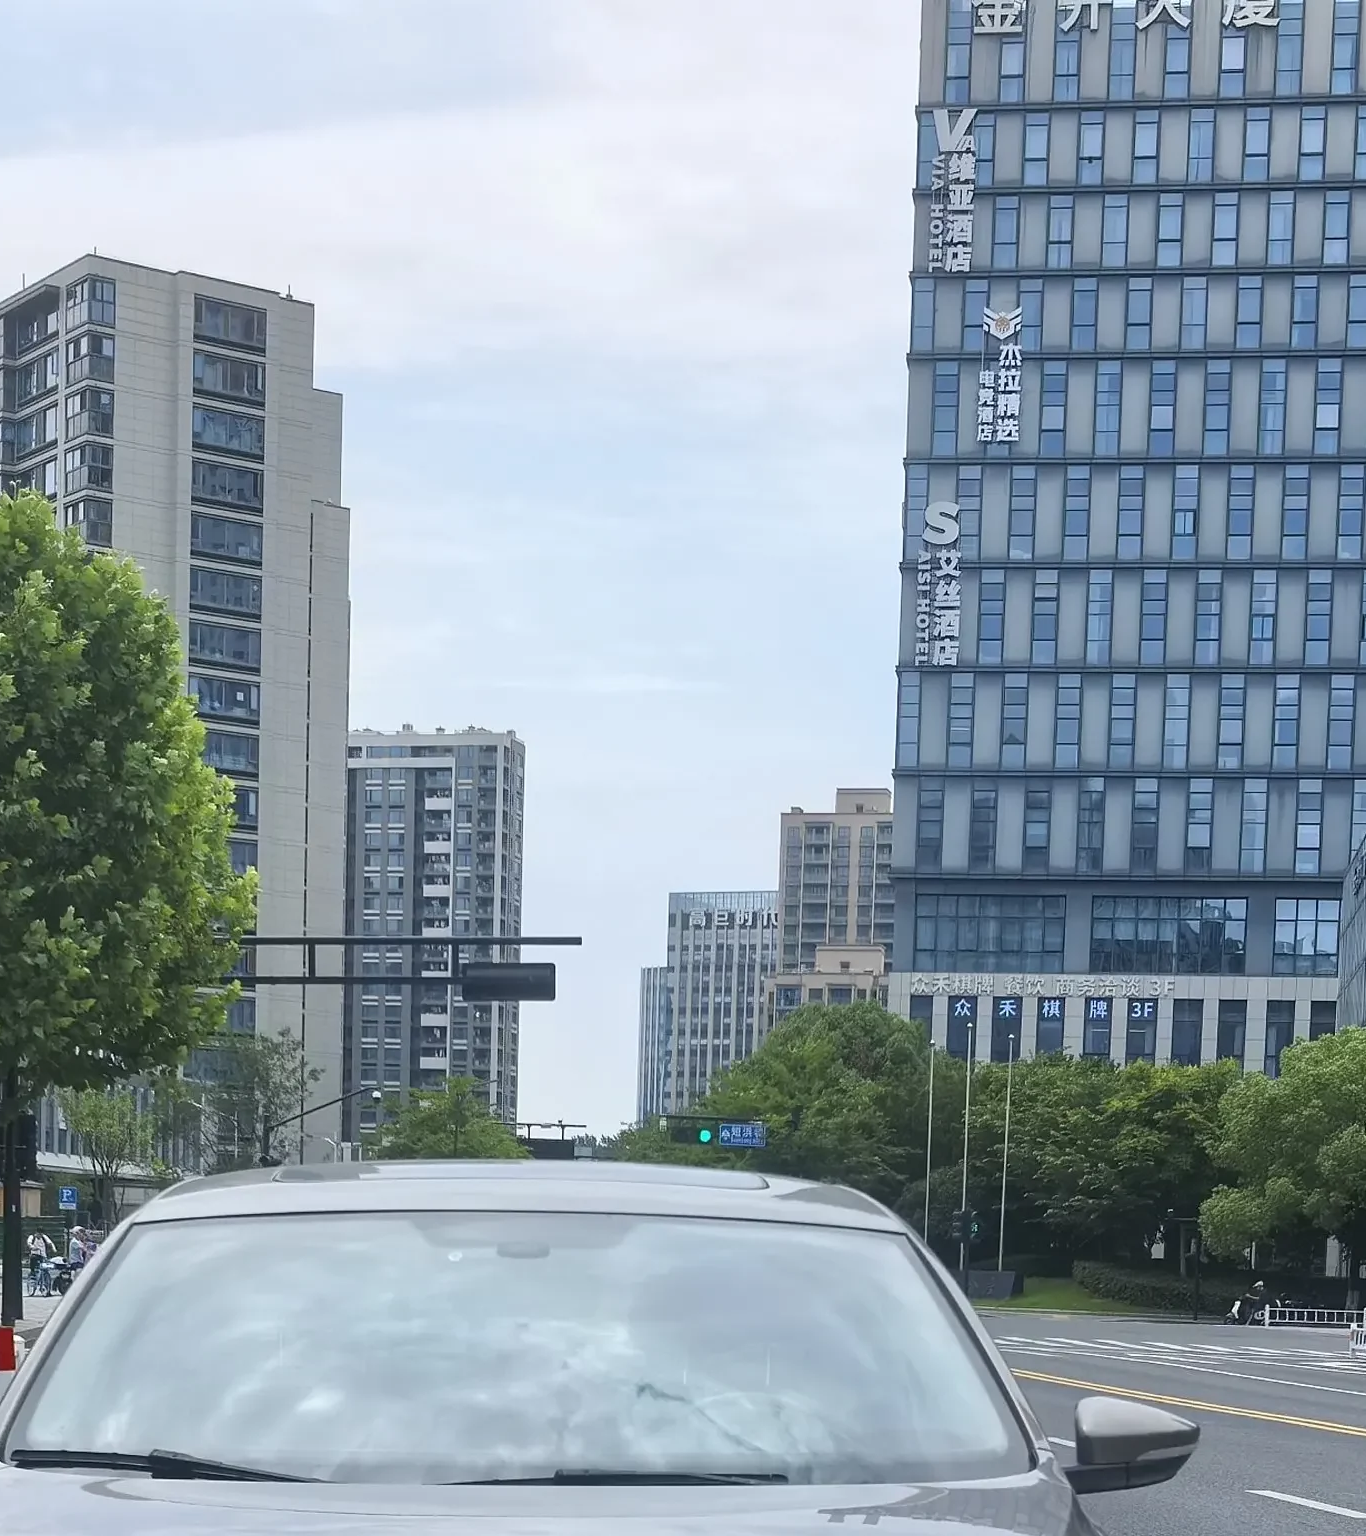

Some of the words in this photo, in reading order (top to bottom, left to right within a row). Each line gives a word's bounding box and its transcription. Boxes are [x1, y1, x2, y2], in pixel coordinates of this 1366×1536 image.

[932, 155, 945, 191] VIA
[928, 204, 945, 272] HOTEL
[945, 153, 976, 272] 维亚酒店
[996, 343, 1023, 442] 杰拉精选
[916, 549, 932, 592] AISI
[914, 598, 931, 667] HOTEL
[932, 549, 962, 667] 艾丝酒店
[1149, 978, 1176, 997] 3F
